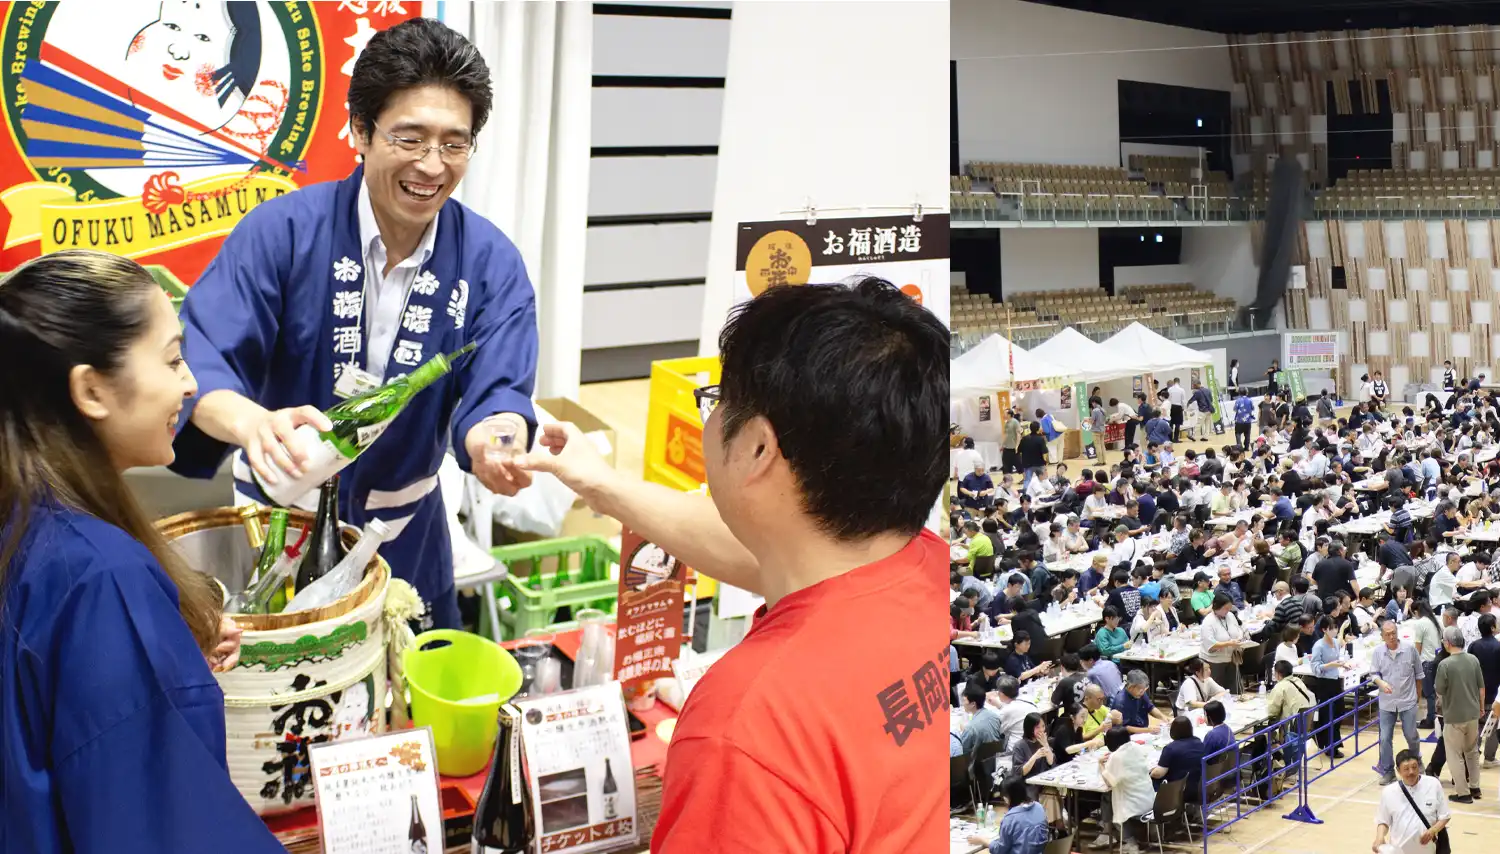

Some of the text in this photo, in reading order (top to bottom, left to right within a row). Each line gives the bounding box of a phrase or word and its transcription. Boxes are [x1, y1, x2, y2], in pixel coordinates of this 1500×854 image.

[53, 217, 133, 246] OFUKU
[822, 224, 921, 256] お福酒造
[876, 645, 950, 747] 長岡
